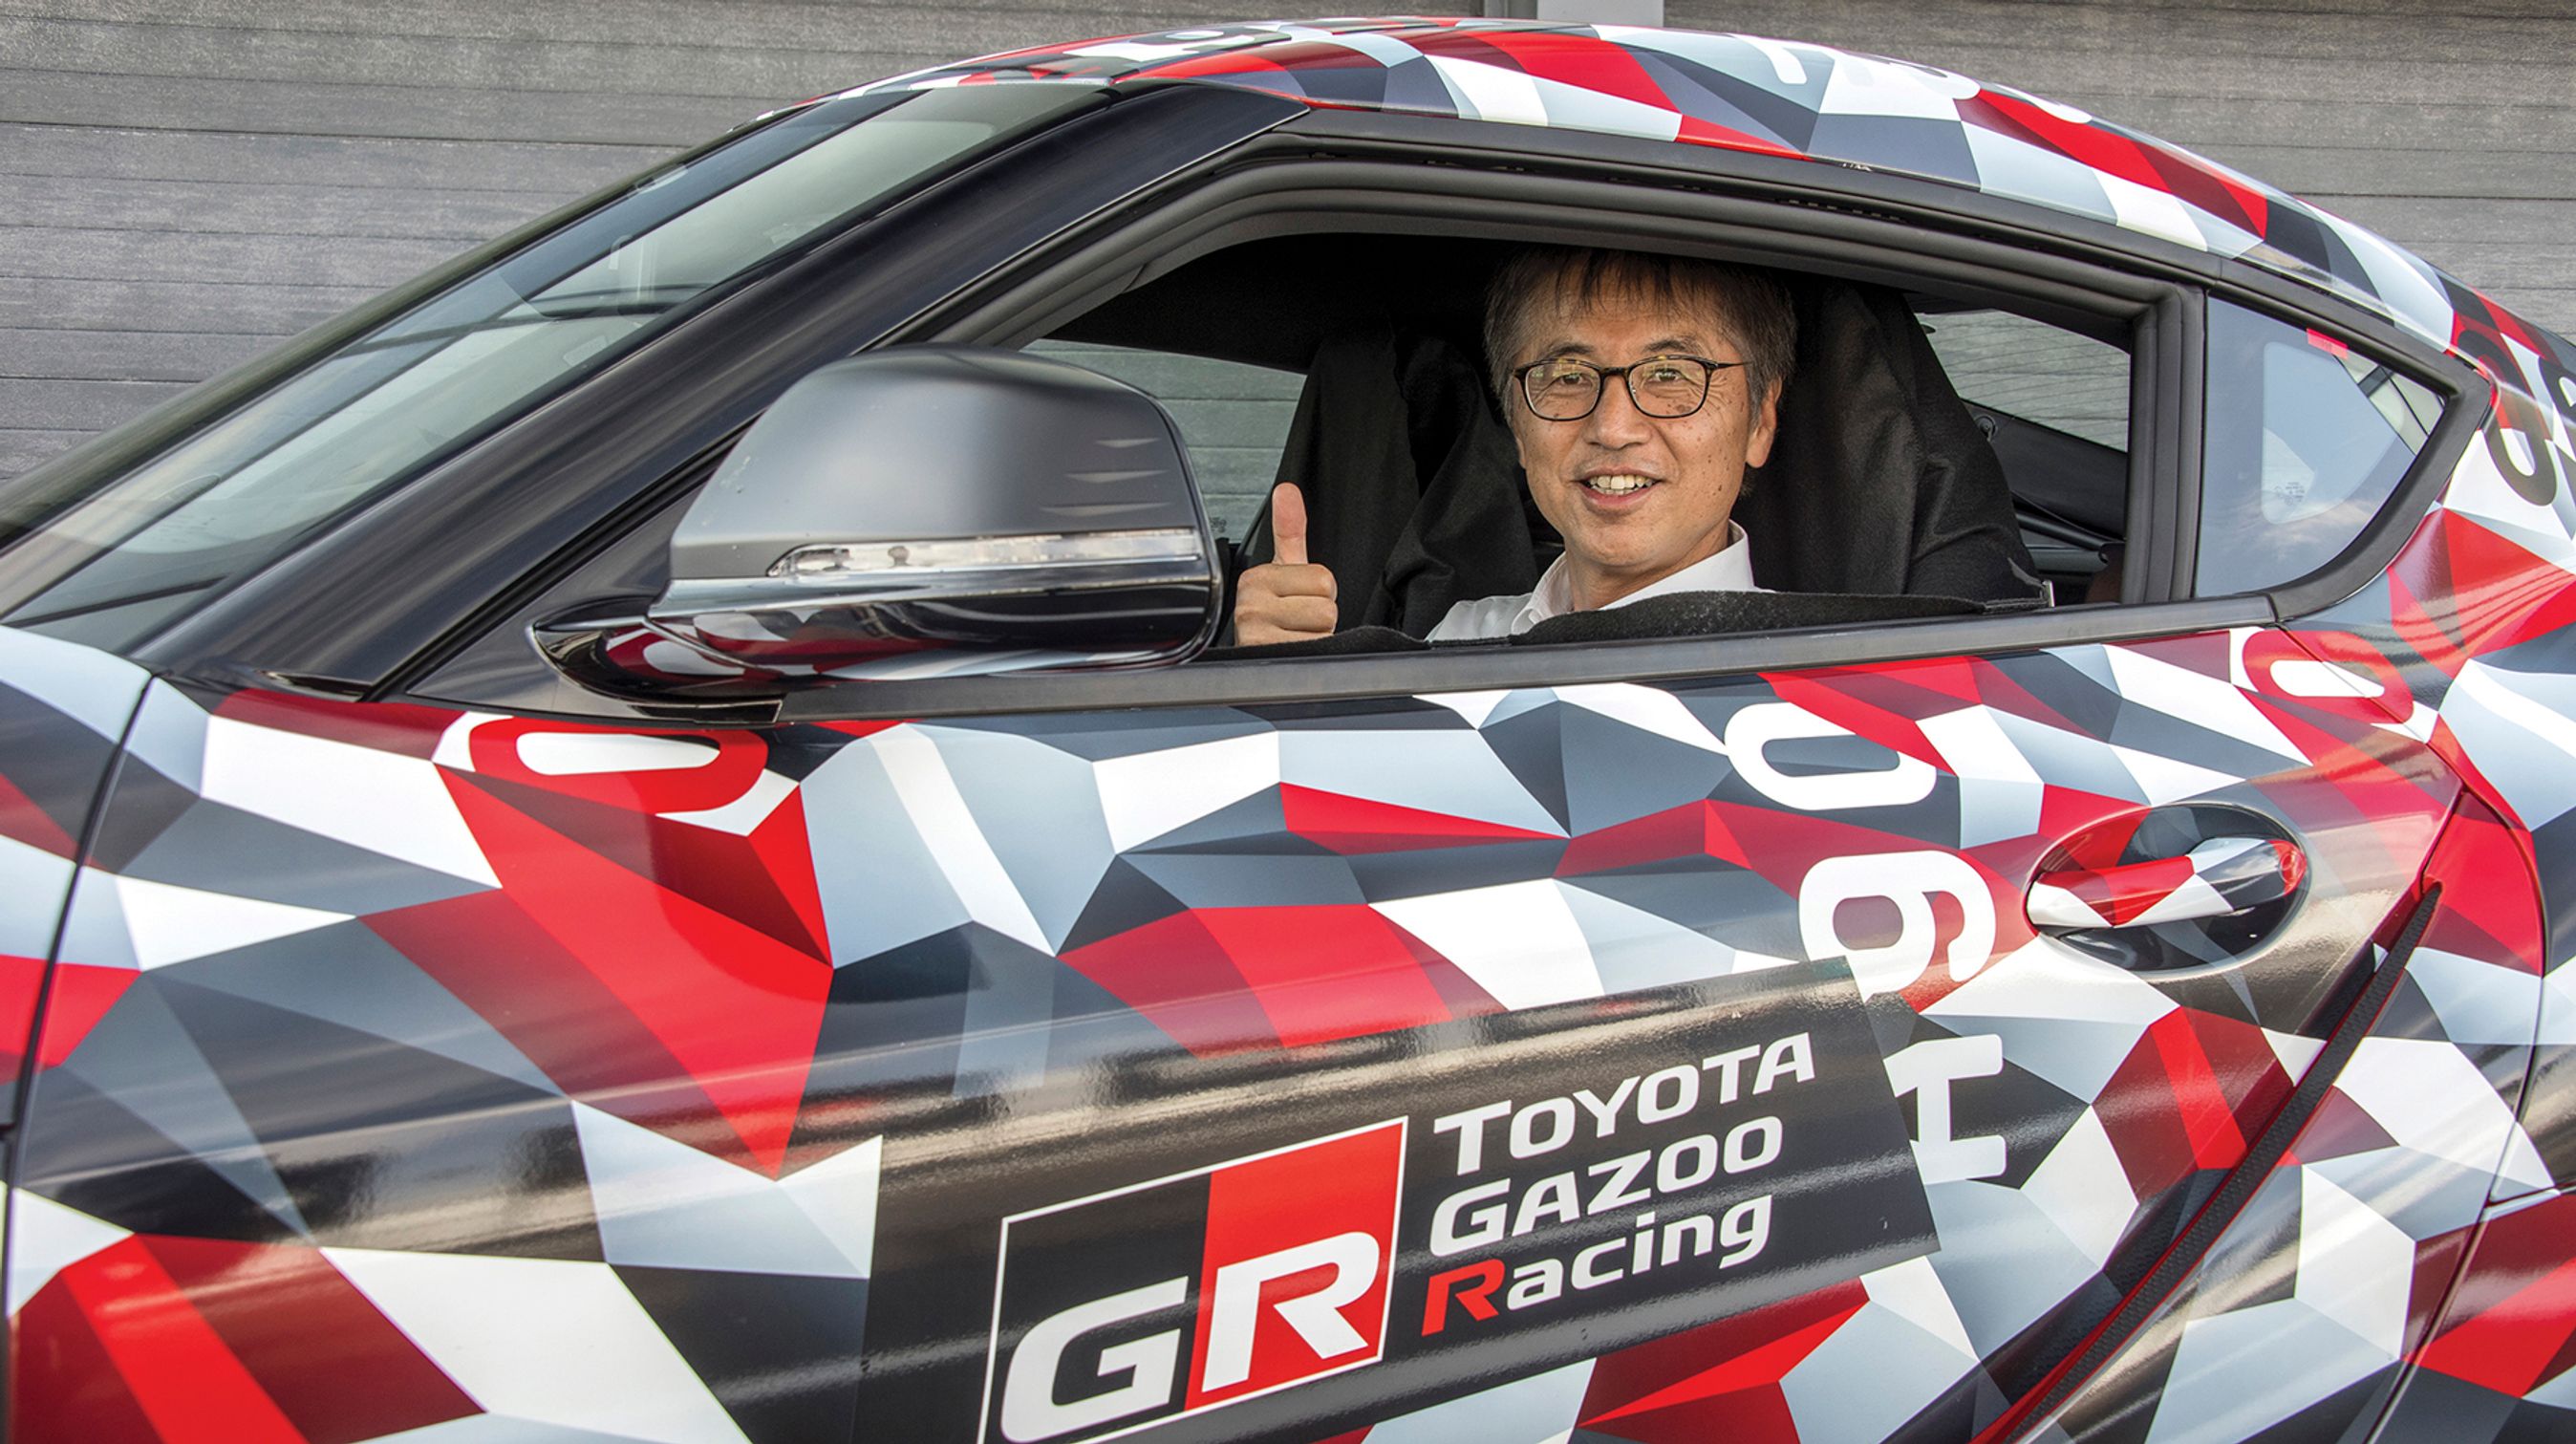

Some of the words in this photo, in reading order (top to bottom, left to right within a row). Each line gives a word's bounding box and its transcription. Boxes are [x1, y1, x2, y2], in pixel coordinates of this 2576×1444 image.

[1433, 1031, 1815, 1176] TOYOTA
[1428, 1115, 1783, 1258] GAZOO
[1000, 1231, 1381, 1444] GR
[1421, 1194, 1772, 1337] Racing
